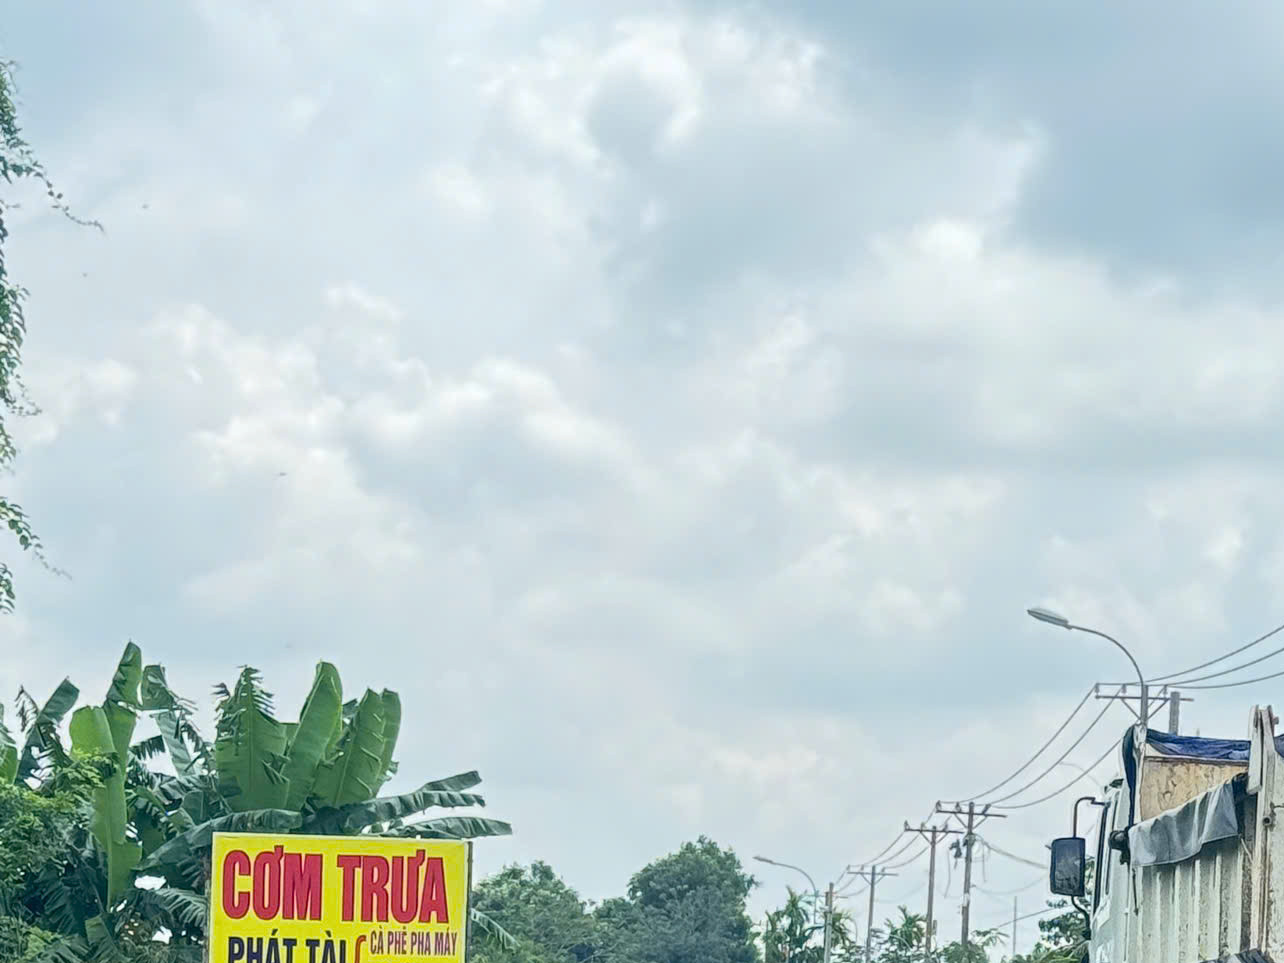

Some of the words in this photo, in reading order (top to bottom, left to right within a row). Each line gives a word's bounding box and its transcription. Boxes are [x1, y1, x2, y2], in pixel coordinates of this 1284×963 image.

[223, 845, 323, 921] CƠM
[337, 849, 449, 923] TRƯA
[370, 925, 384, 955] CÀ
[410, 931, 431, 956] PHA
[434, 927, 457, 956] MÁY
